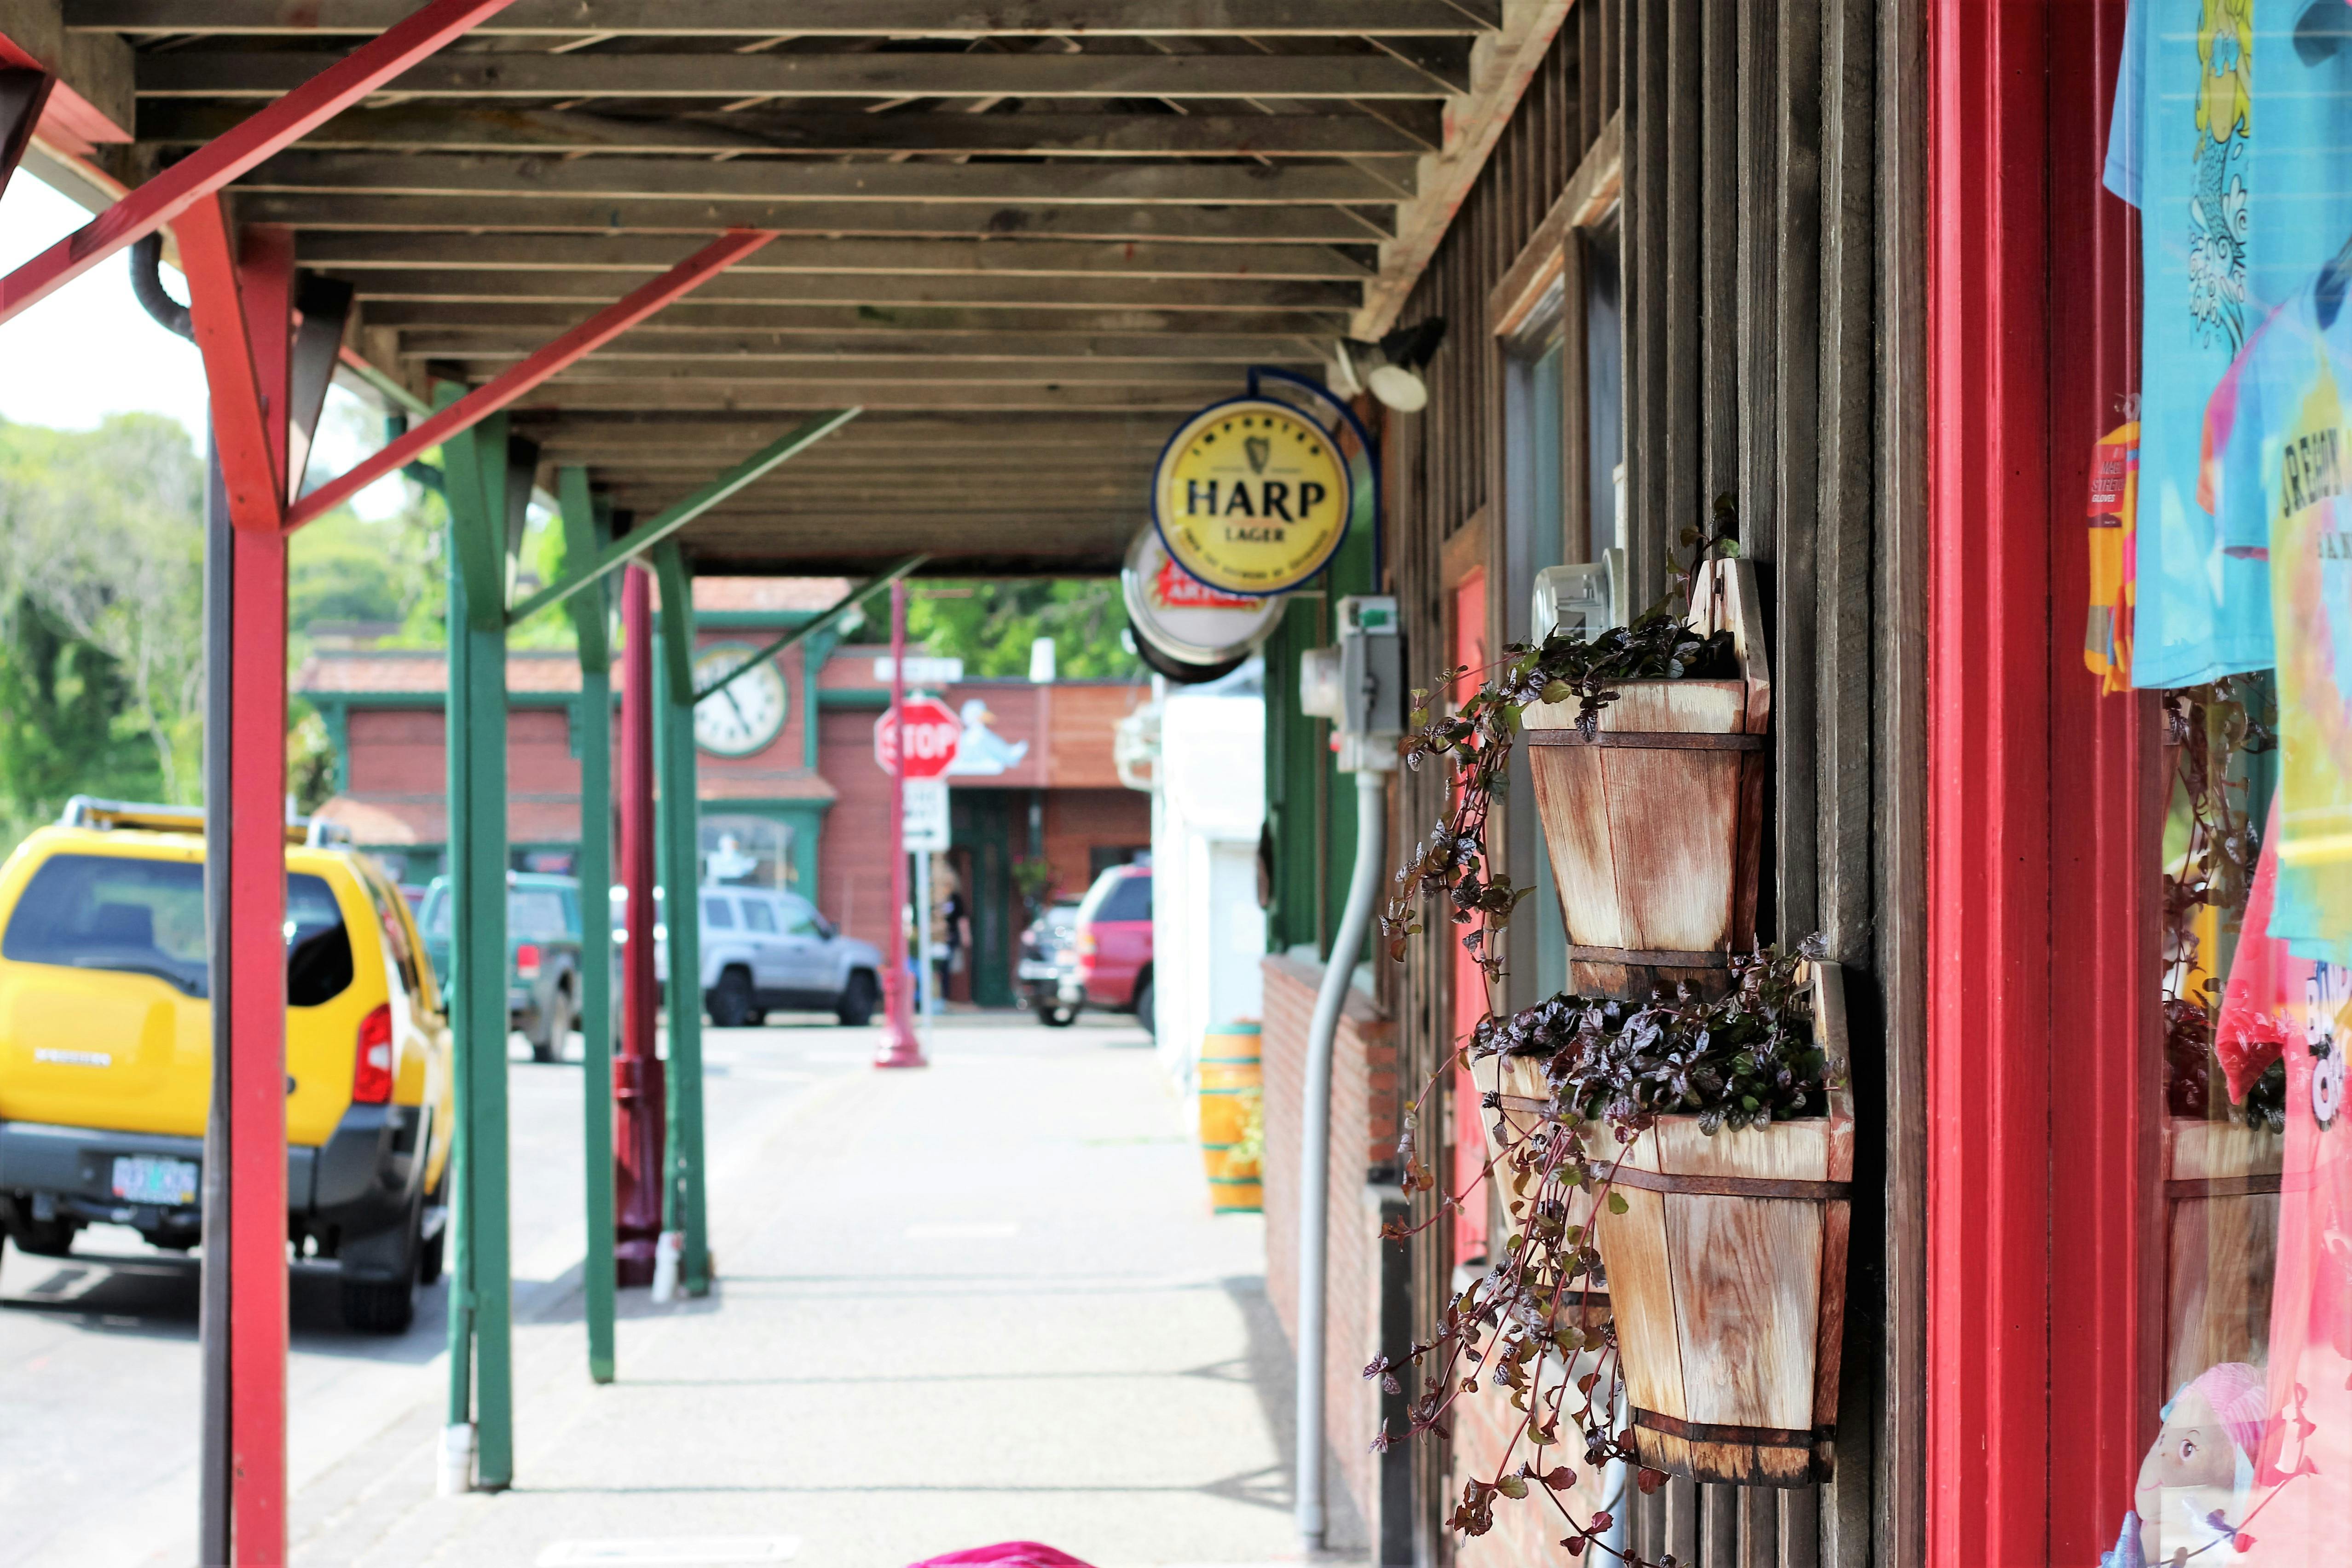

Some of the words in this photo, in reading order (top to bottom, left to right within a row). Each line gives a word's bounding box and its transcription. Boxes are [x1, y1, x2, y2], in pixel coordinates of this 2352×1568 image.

[1186, 478, 1327, 524] HARP
[2092, 494, 2115, 503] GLOVES
[1224, 527, 1286, 543] LAGER
[883, 723, 957, 760] STOP
